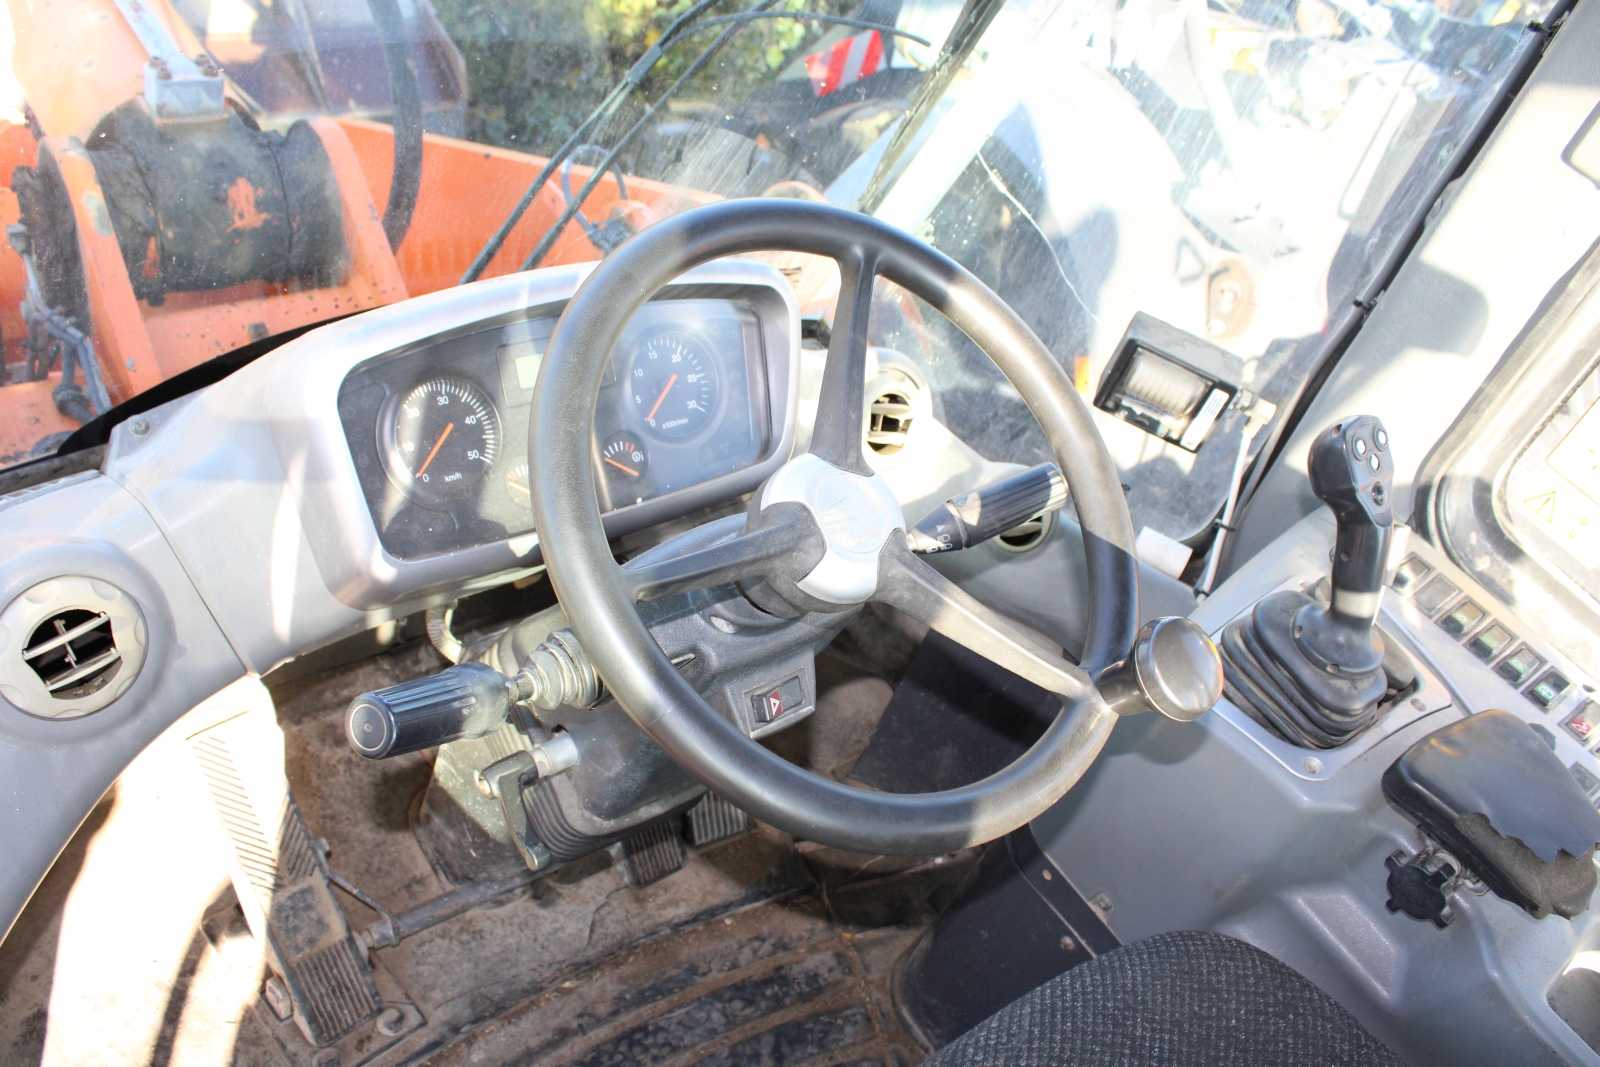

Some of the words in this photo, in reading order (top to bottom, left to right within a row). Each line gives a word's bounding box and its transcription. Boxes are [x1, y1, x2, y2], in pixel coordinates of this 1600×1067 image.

[648, 350, 658, 360] 15
[671, 354, 682, 363] 20
[633, 368, 644, 378] 10
[687, 373, 698, 383] 25
[437, 395, 449, 405] 30
[635, 395, 642, 404] 5
[686, 400, 697, 409] 30
[406, 408, 420, 419] 20
[464, 415, 477, 425] 40
[649, 419, 656, 427] 0
[402, 442, 415, 452] 10
[467, 449, 480, 460] 50
[422, 474, 429, 482] 0
[444, 472, 463, 483] km/h
